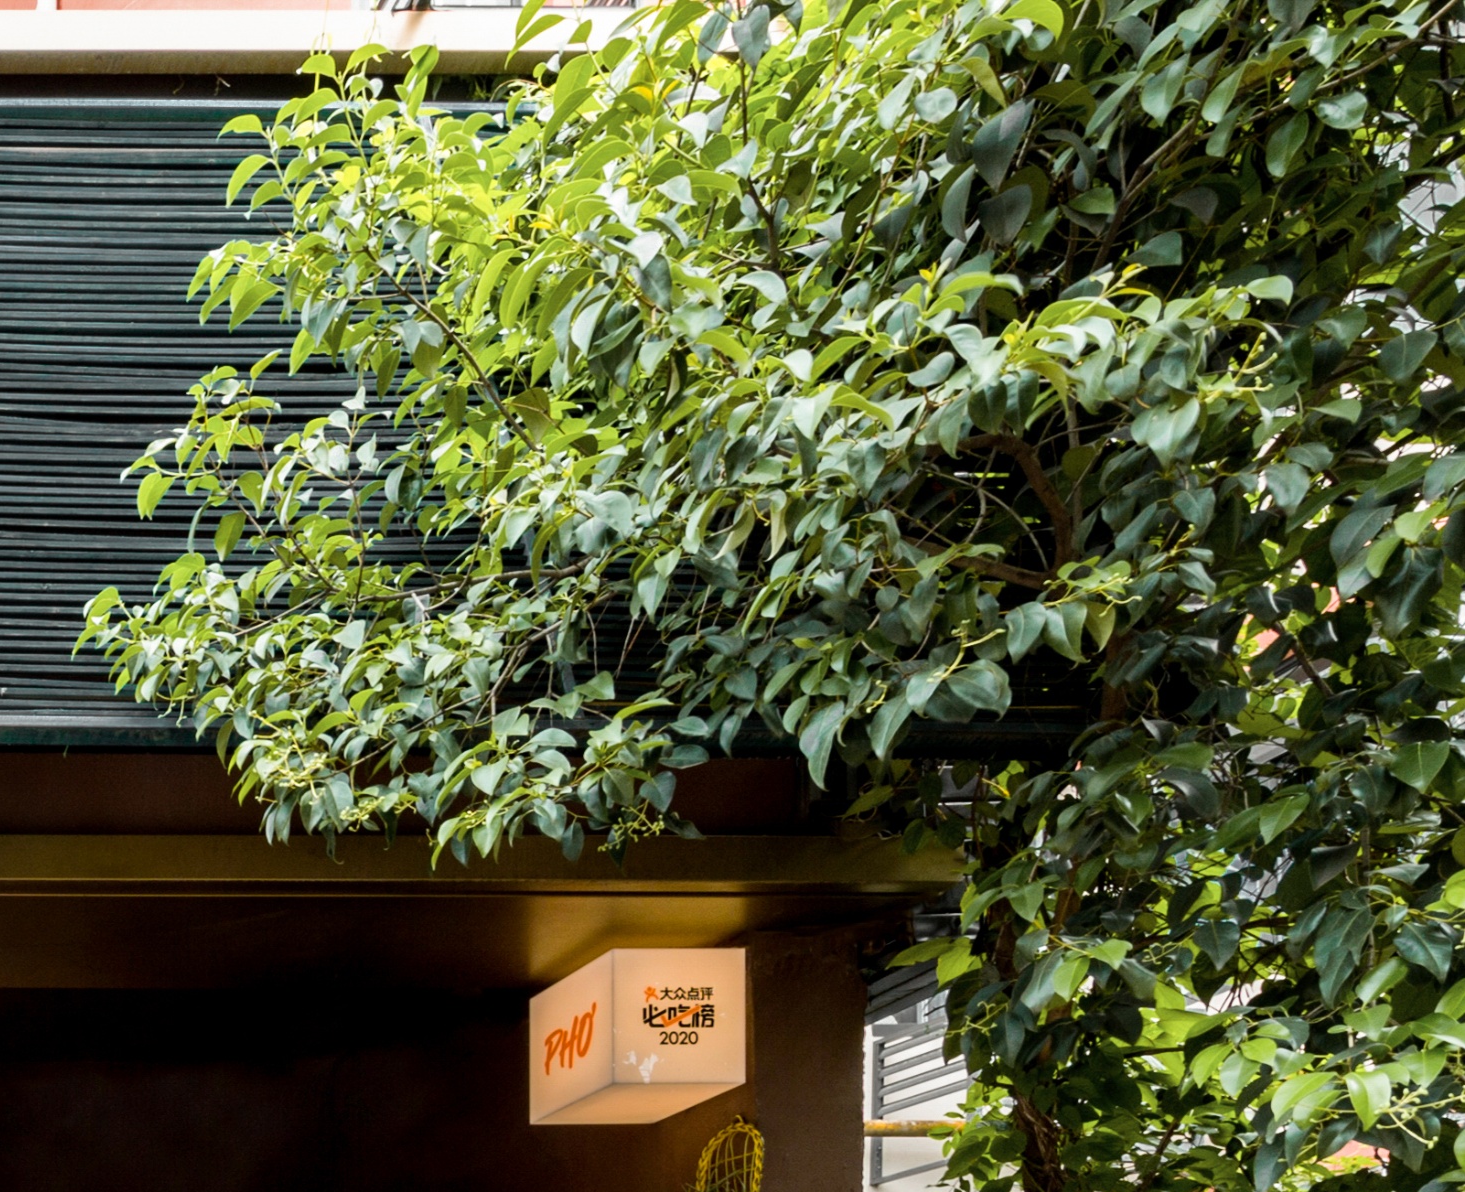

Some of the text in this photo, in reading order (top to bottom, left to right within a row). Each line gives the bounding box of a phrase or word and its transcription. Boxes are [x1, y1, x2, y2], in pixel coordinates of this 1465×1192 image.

[659, 986, 714, 1001] 大众点评
[642, 1003, 715, 1028] 必吃榜
[659, 1031, 699, 1046] 2020
